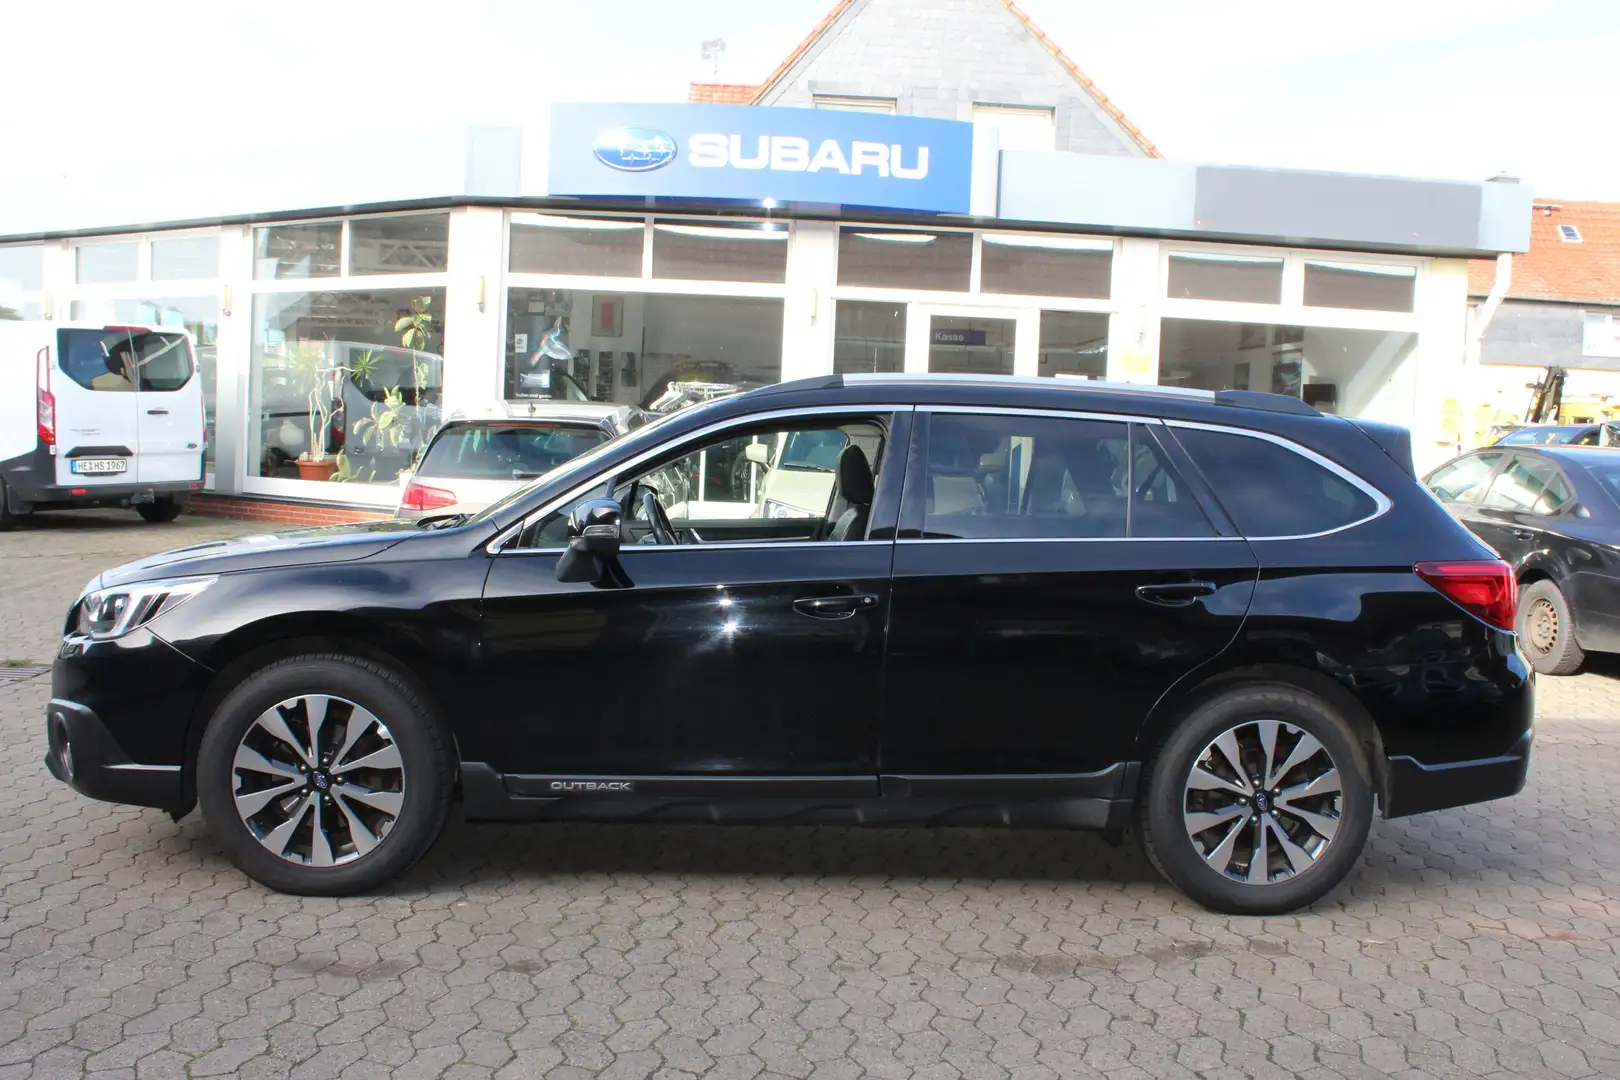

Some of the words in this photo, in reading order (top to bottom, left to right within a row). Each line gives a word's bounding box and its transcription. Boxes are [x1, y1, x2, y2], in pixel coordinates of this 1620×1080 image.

[688, 132, 929, 180] SUBARU
[935, 331, 965, 342] Kasse
[78, 461, 88, 471] HE
[94, 461, 105, 471] HS
[106, 460, 126, 471] 1967
[550, 781, 631, 791] OUTBACK
